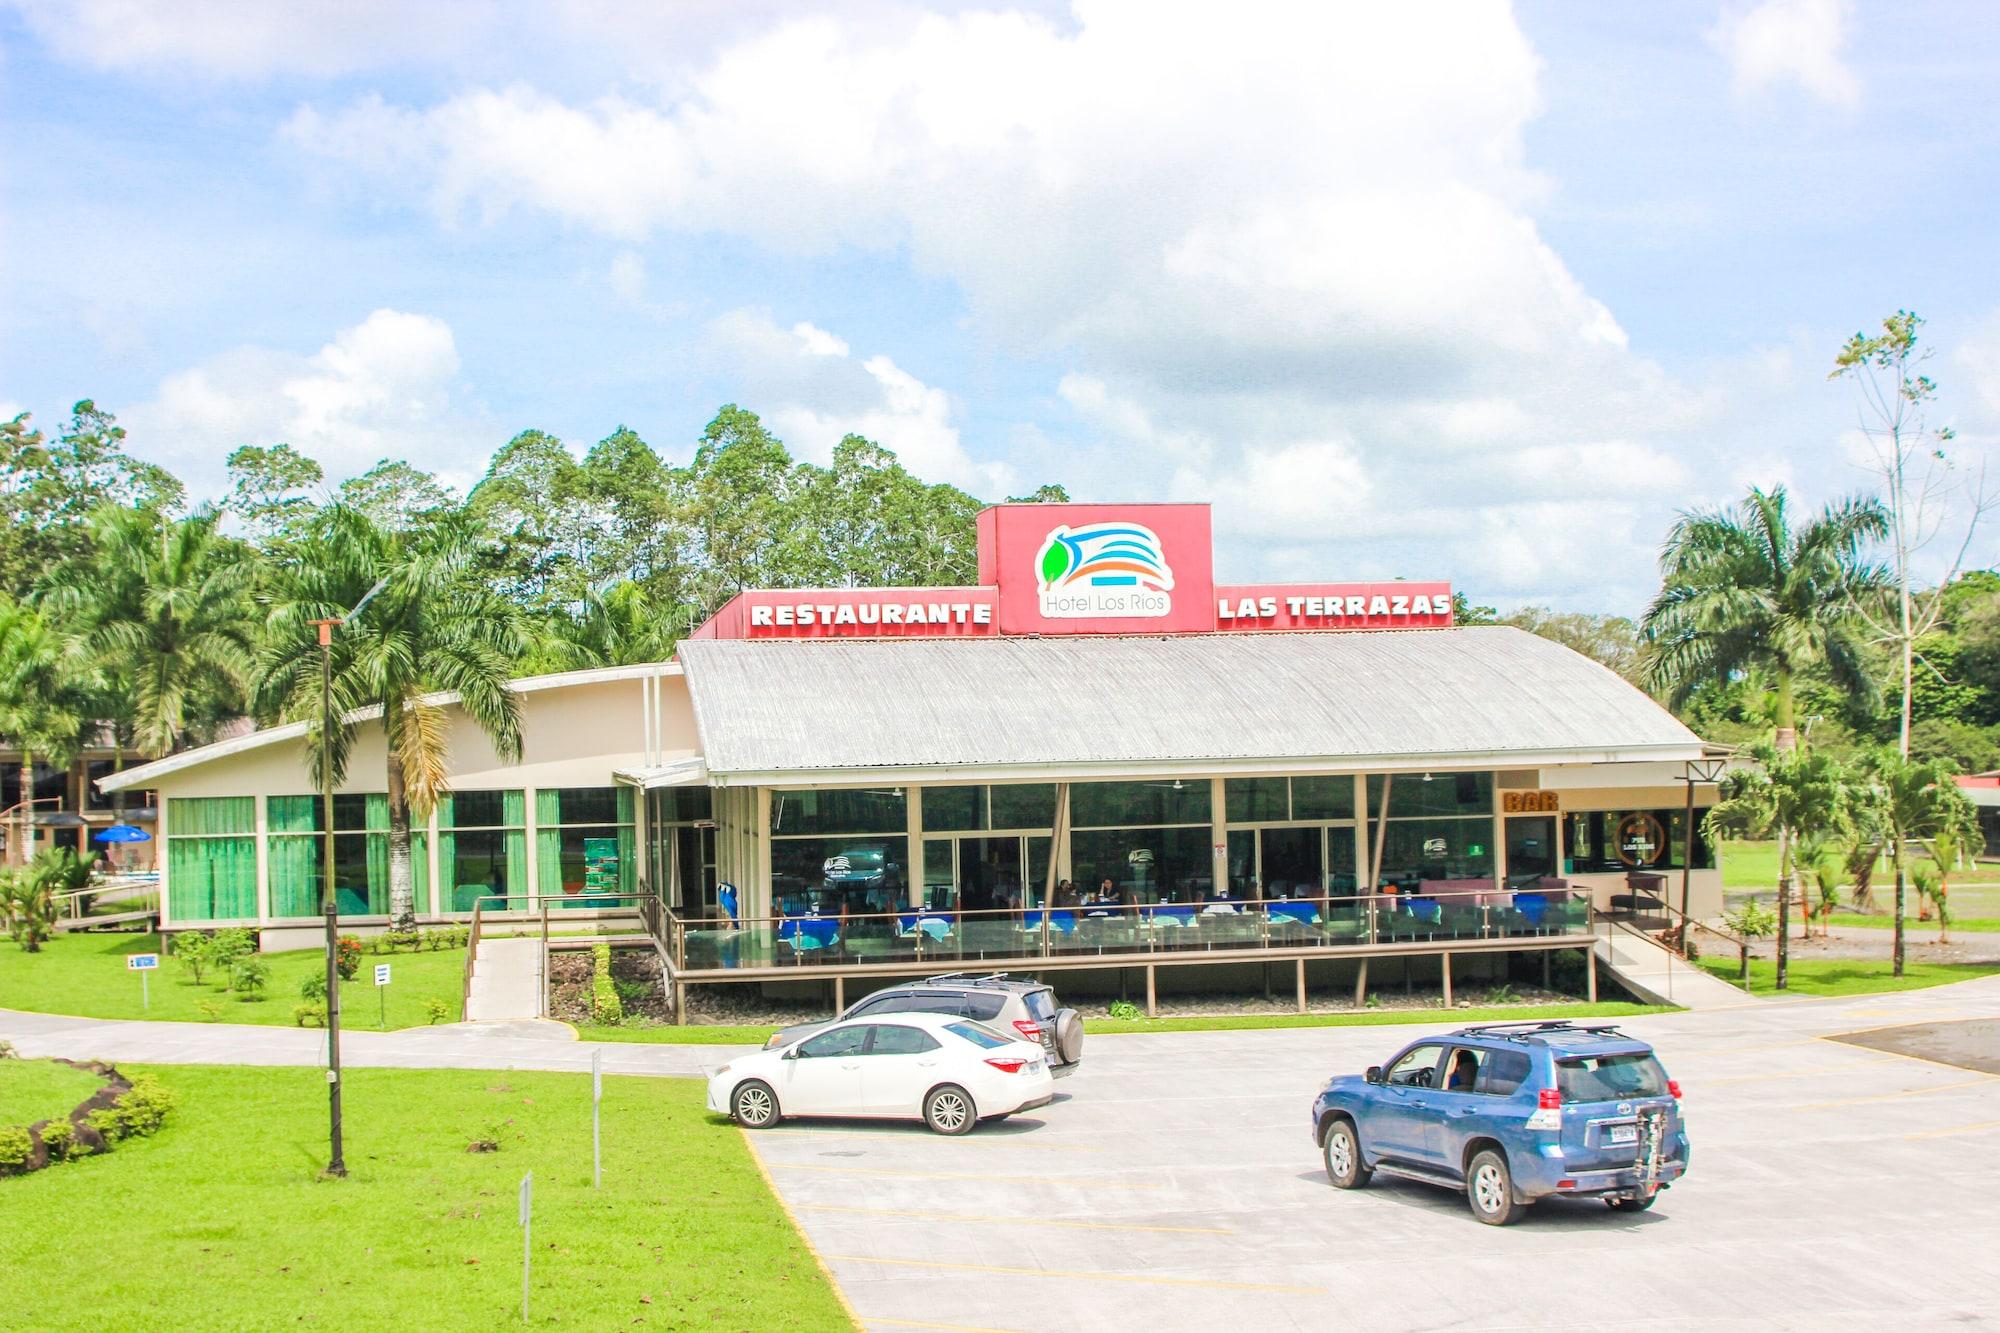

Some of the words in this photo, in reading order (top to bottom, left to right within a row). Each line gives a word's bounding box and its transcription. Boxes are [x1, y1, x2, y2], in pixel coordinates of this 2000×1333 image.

[1046, 595, 1092, 611] Hotel
[1097, 595, 1125, 611] Los
[1130, 593, 1164, 610] Ríos
[1218, 597, 1278, 619] LAS
[1286, 595, 1451, 616] TERRAZAS
[750, 603, 992, 626] RESTAURANTE
[1503, 791, 1559, 813] BAR
